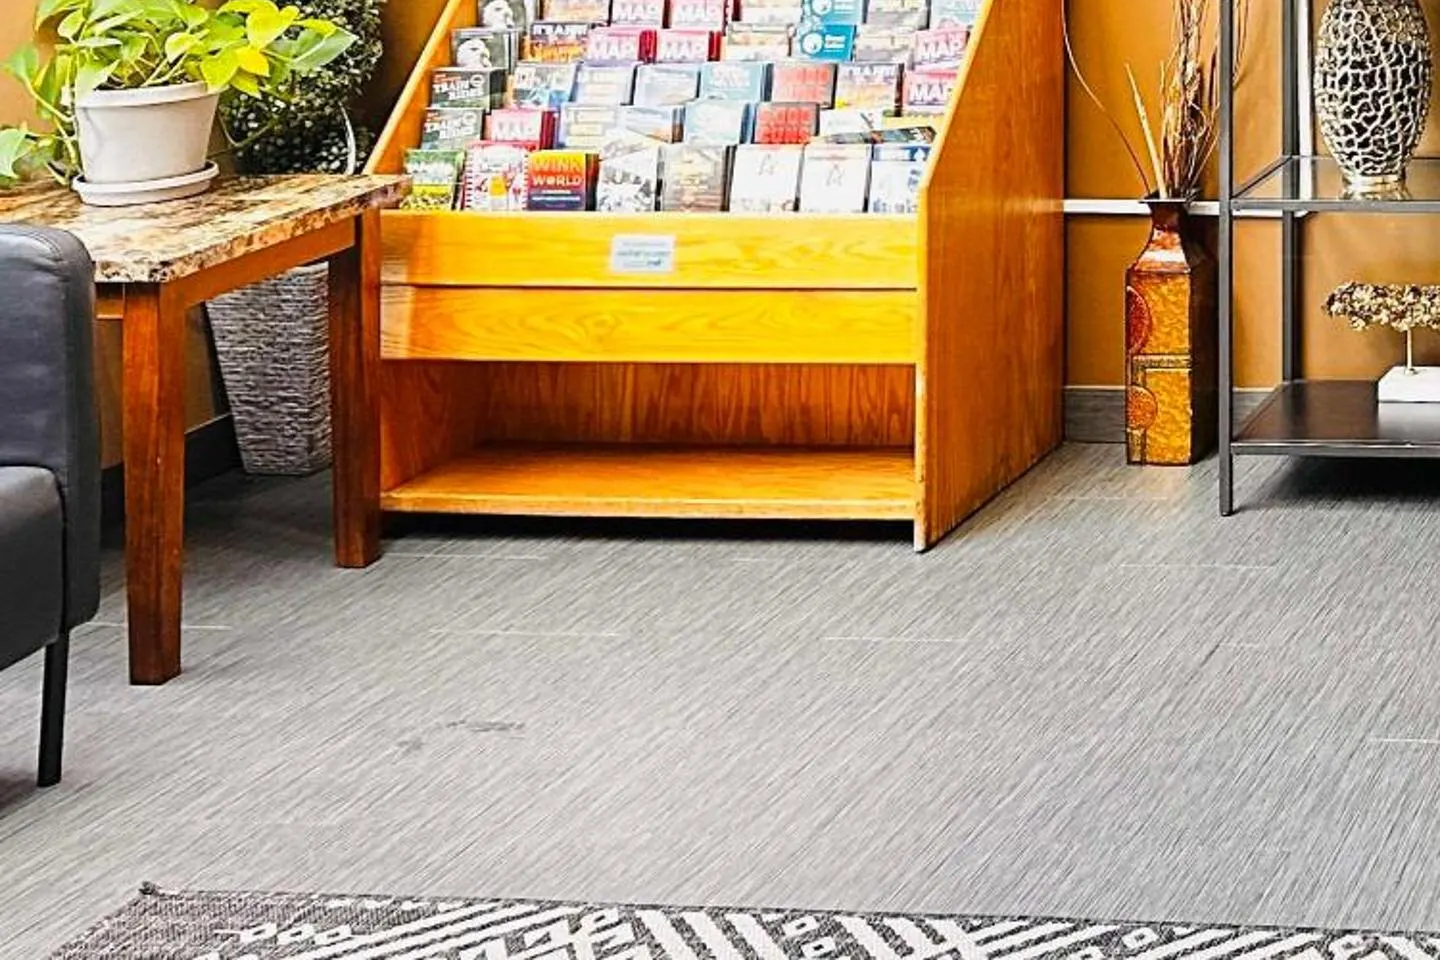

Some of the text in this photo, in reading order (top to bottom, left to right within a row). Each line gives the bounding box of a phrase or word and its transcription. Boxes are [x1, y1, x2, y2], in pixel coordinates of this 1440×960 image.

[613, 1, 661, 21] MAP
[676, 2, 722, 22] MAP
[588, 40, 636, 61] MAP
[660, 40, 705, 61] MAP
[918, 38, 961, 59] MAP
[532, 175, 582, 187] WORLD
